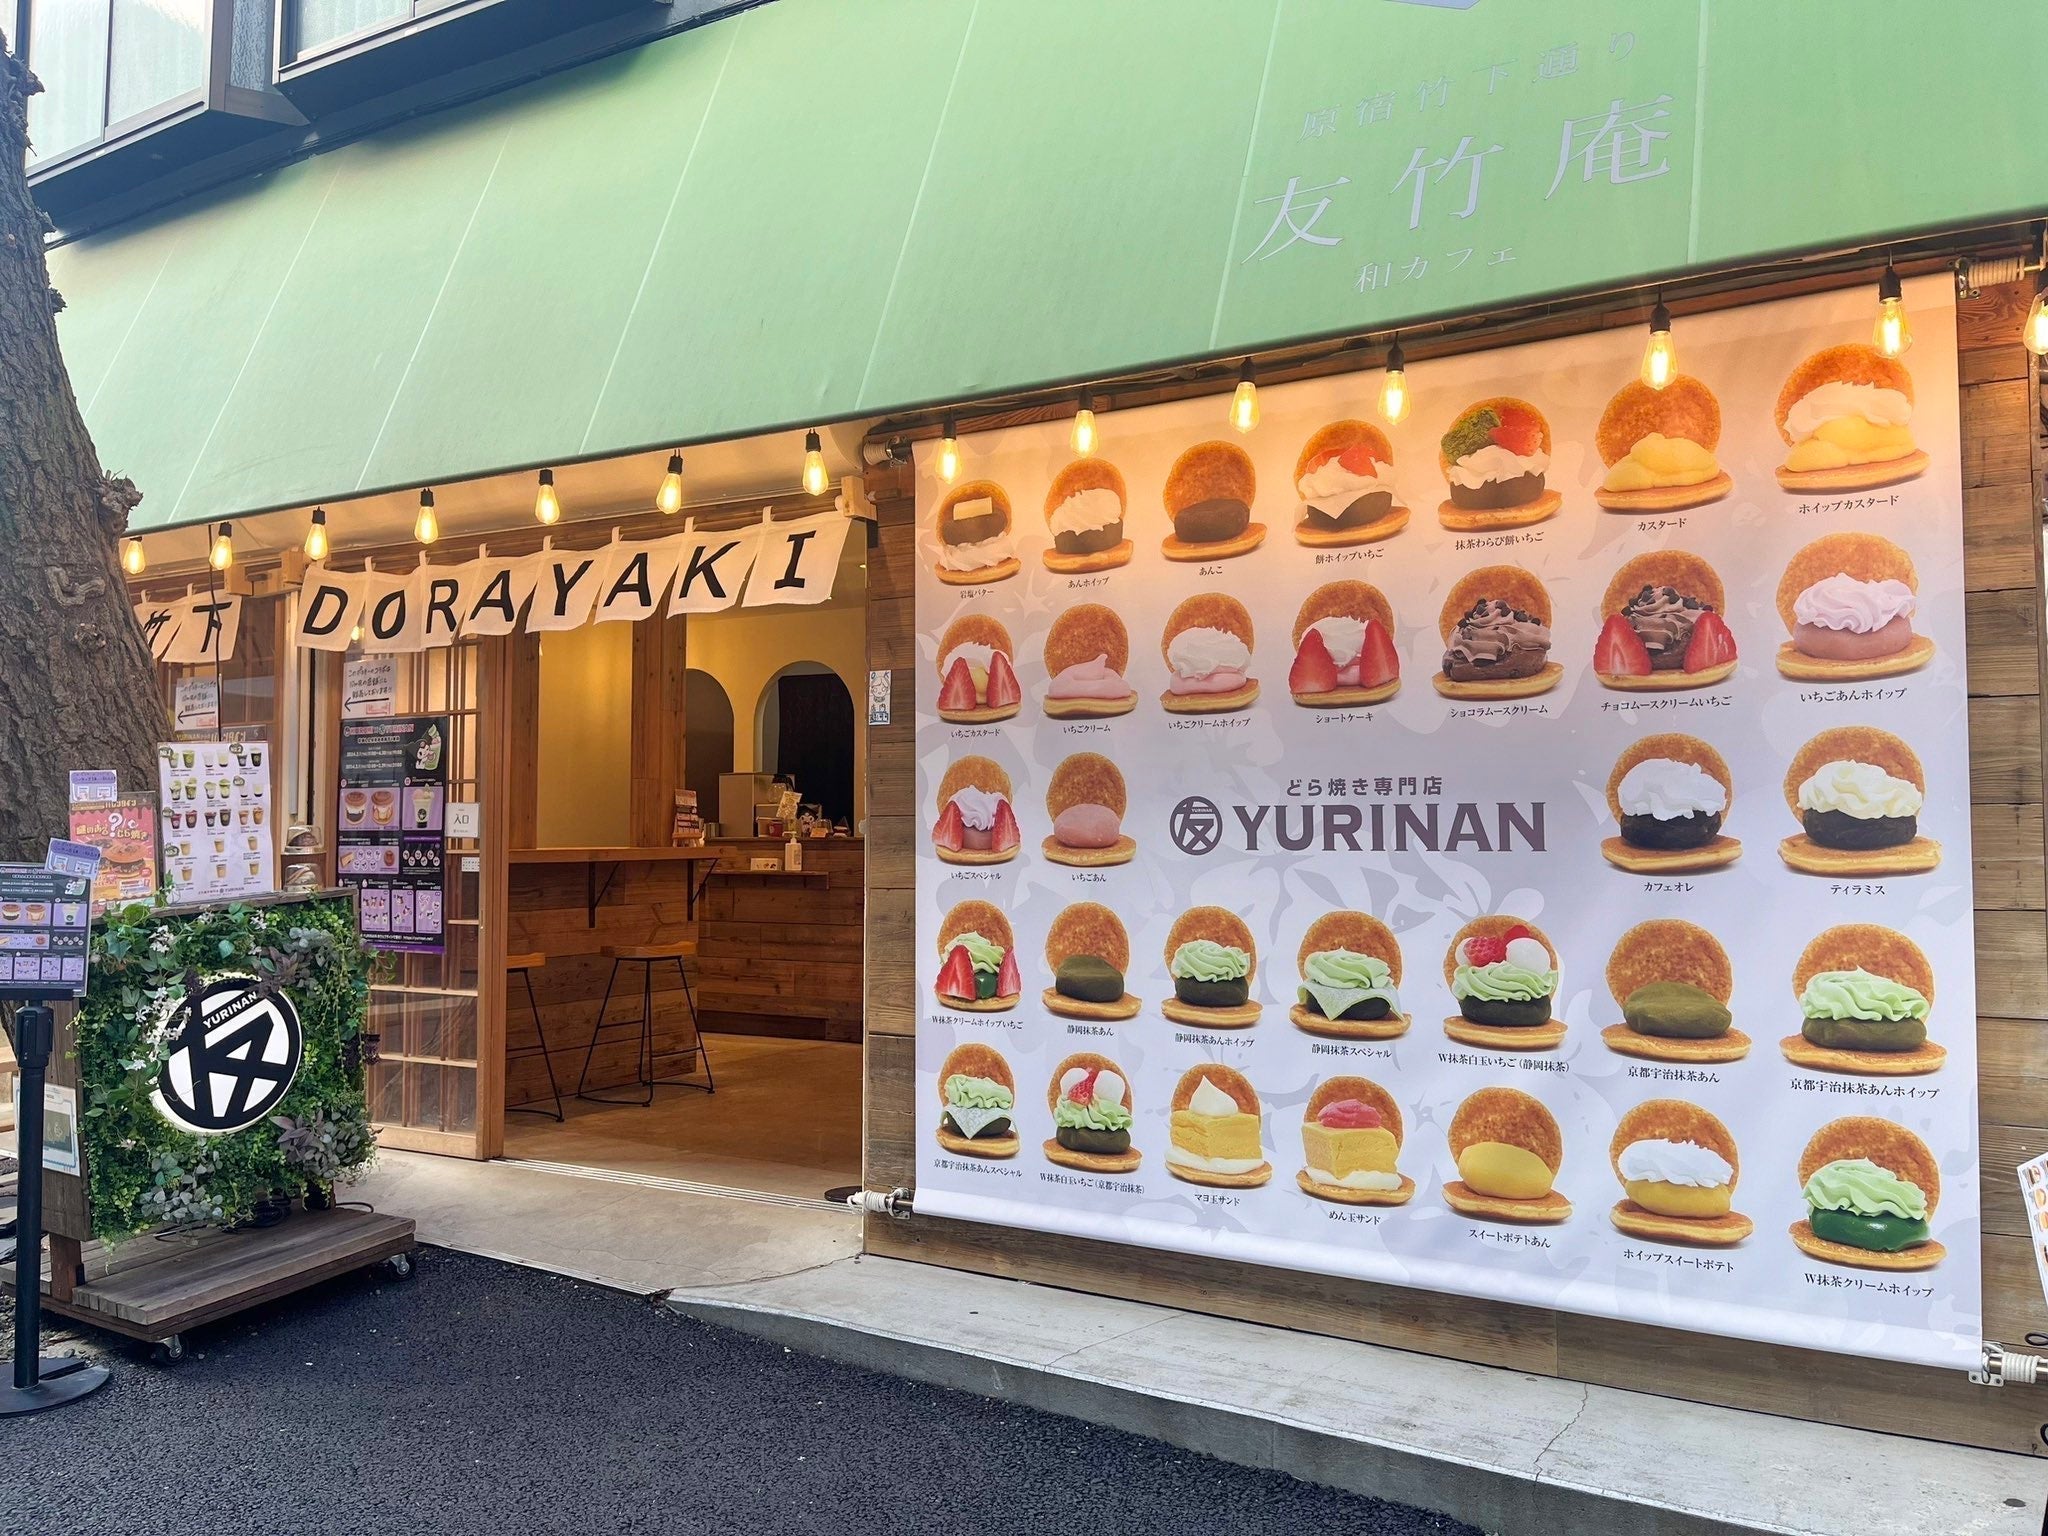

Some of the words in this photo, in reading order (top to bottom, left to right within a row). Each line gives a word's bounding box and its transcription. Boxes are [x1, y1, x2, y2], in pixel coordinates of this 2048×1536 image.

[1297, 31, 1636, 144] 原宿竹下通り
[1241, 94, 1675, 265] 友竹庵
[1353, 247, 1518, 295] 和カフェ
[1798, 494, 1900, 515] ホイップカスタード
[1637, 517, 1687, 532] カスタード
[1454, 531, 1545, 551] 抹茶わらび餅いちご
[1314, 548, 1385, 565] 餅ホイップいちご
[1198, 565, 1224, 576] あんこ
[302, 530, 817, 641] DORAYAKI
[1067, 576, 1110, 589] あんホイップ
[1600, 694, 1733, 711] チョコムースクリームいちご
[1800, 687, 1907, 702] いちごあんホイップ
[1315, 712, 1374, 724] ショートケーキ
[1450, 703, 1549, 719] ショコラムースクリーム
[1063, 723, 1111, 735] いちごクリーム
[1168, 717, 1251, 730] いちごクリームホイップ
[950, 728, 1001, 739] いちごカスタード
[1286, 775, 1443, 796] どら焼き専門店
[1232, 802, 1548, 853] YURINAN
[950, 871, 1002, 881] いちごスペシャル
[1071, 873, 1107, 883] いちごあん
[1643, 881, 1695, 893] カフェオレ
[1829, 883, 1886, 896] ティラミス
[203, 991, 260, 1029] YURINAN
[931, 1015, 1024, 1030] W抹茶クリームホイップいちご
[1066, 1025, 1114, 1037] 静岡抹茶あん
[1174, 1032, 1255, 1048] 静岡抹茶あんホイップ
[1311, 1043, 1393, 1059] 静岡抹茶スペシャル
[1627, 1066, 1721, 1084] 京都宇治抹茶あん
[1790, 1078, 1939, 1098] 京都宇治抹茶あんホイップ
[933, 1158, 1023, 1178] 京都宇治抹茶あんスペシャル
[1194, 1193, 1241, 1207] マヨ玉サンド
[1328, 1211, 1381, 1226] めん玉サンド
[1469, 1229, 1551, 1247] スイートポテトあん
[1623, 1248, 1735, 1272] ホイップスイートポテト
[1804, 1272, 1935, 1298] W抹茶クリームホイップ
